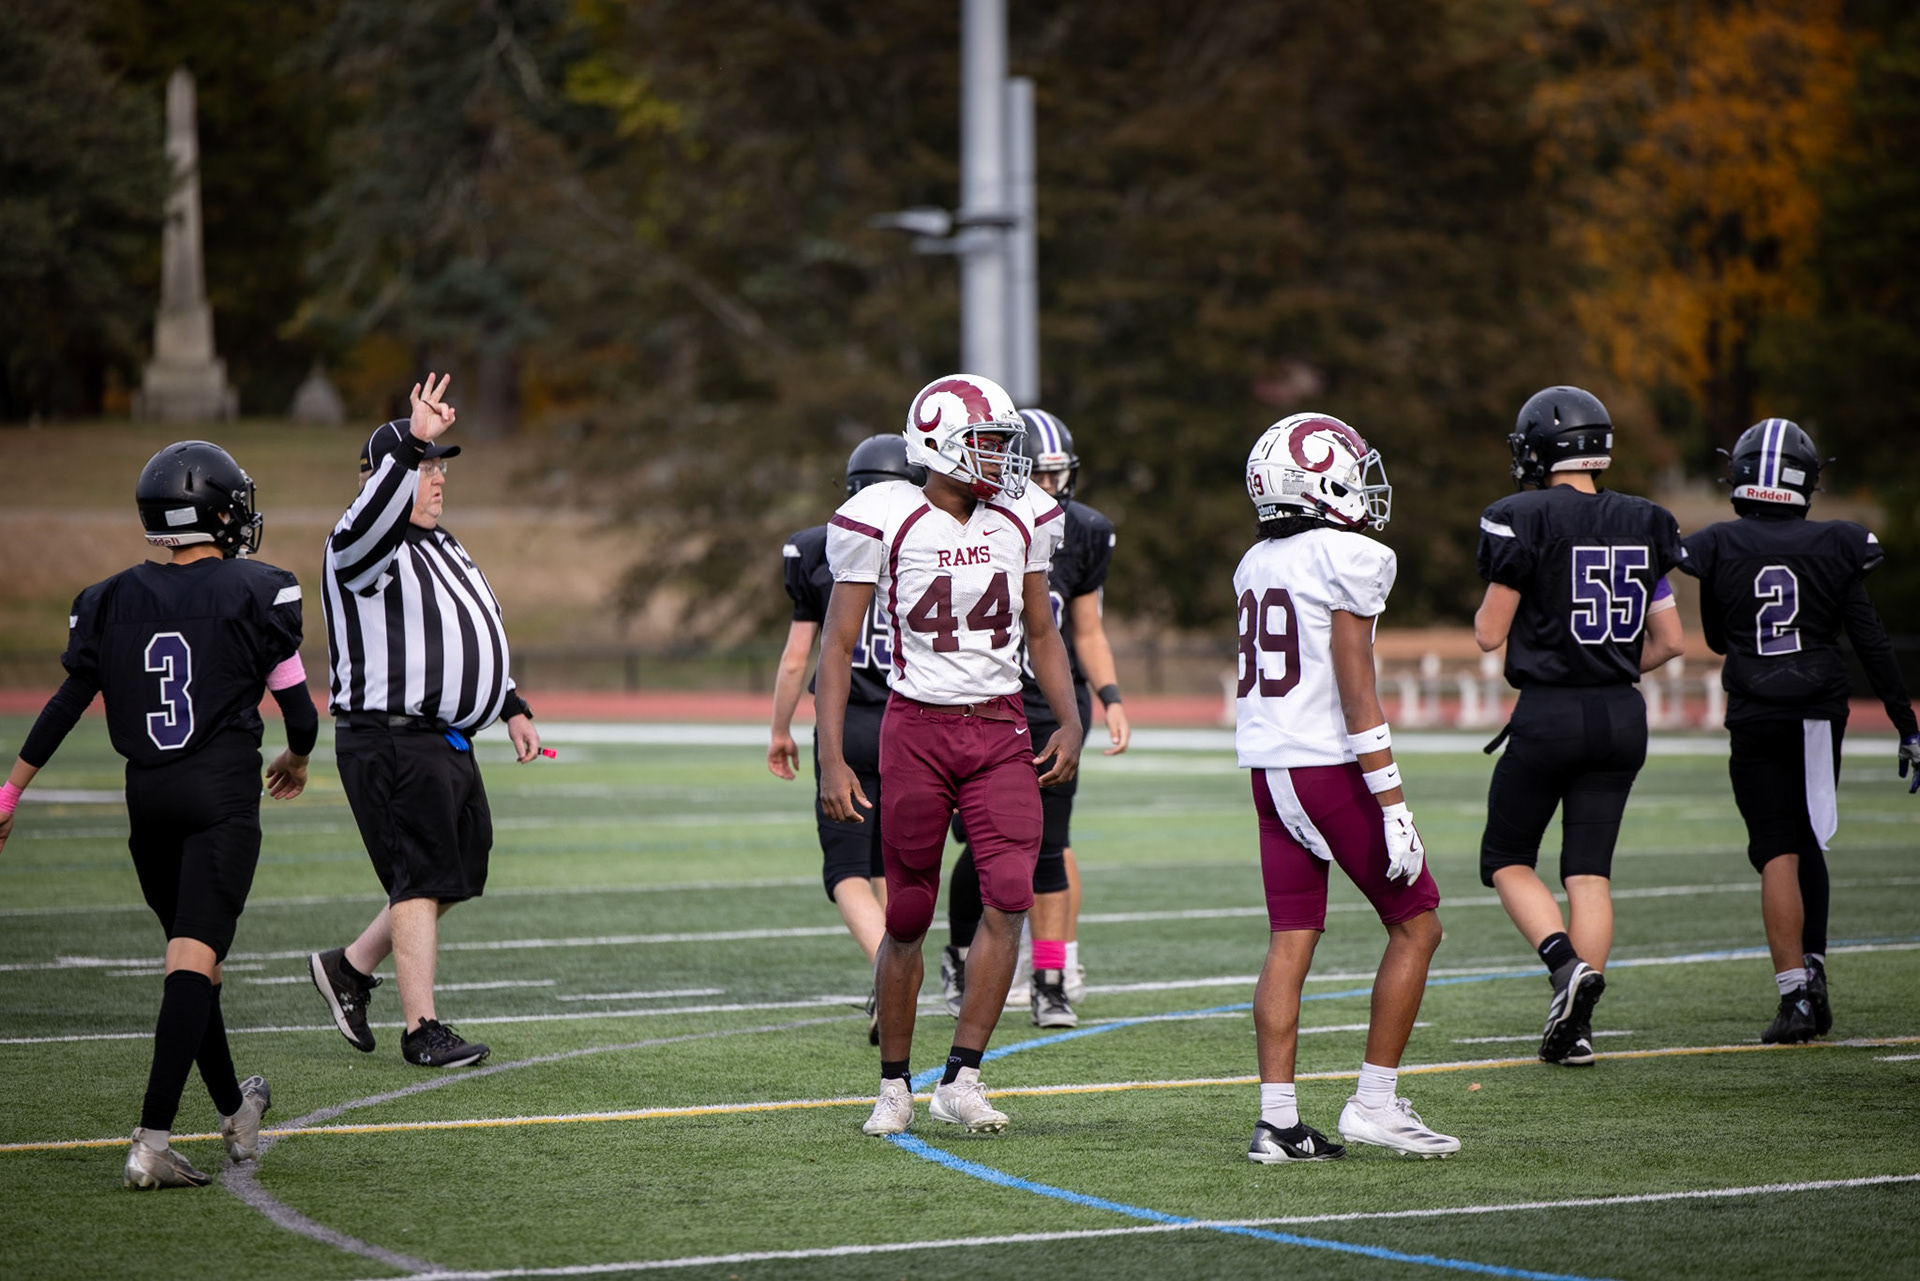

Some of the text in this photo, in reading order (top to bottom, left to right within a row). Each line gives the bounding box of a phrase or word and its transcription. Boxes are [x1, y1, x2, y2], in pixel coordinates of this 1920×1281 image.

[1746, 487, 1792, 502] Riddell
[937, 545, 991, 568] RAMS
[1571, 546, 1649, 644] 55
[906, 571, 1013, 653] 44
[1754, 564, 1802, 656] 2
[144, 631, 194, 751] 3
